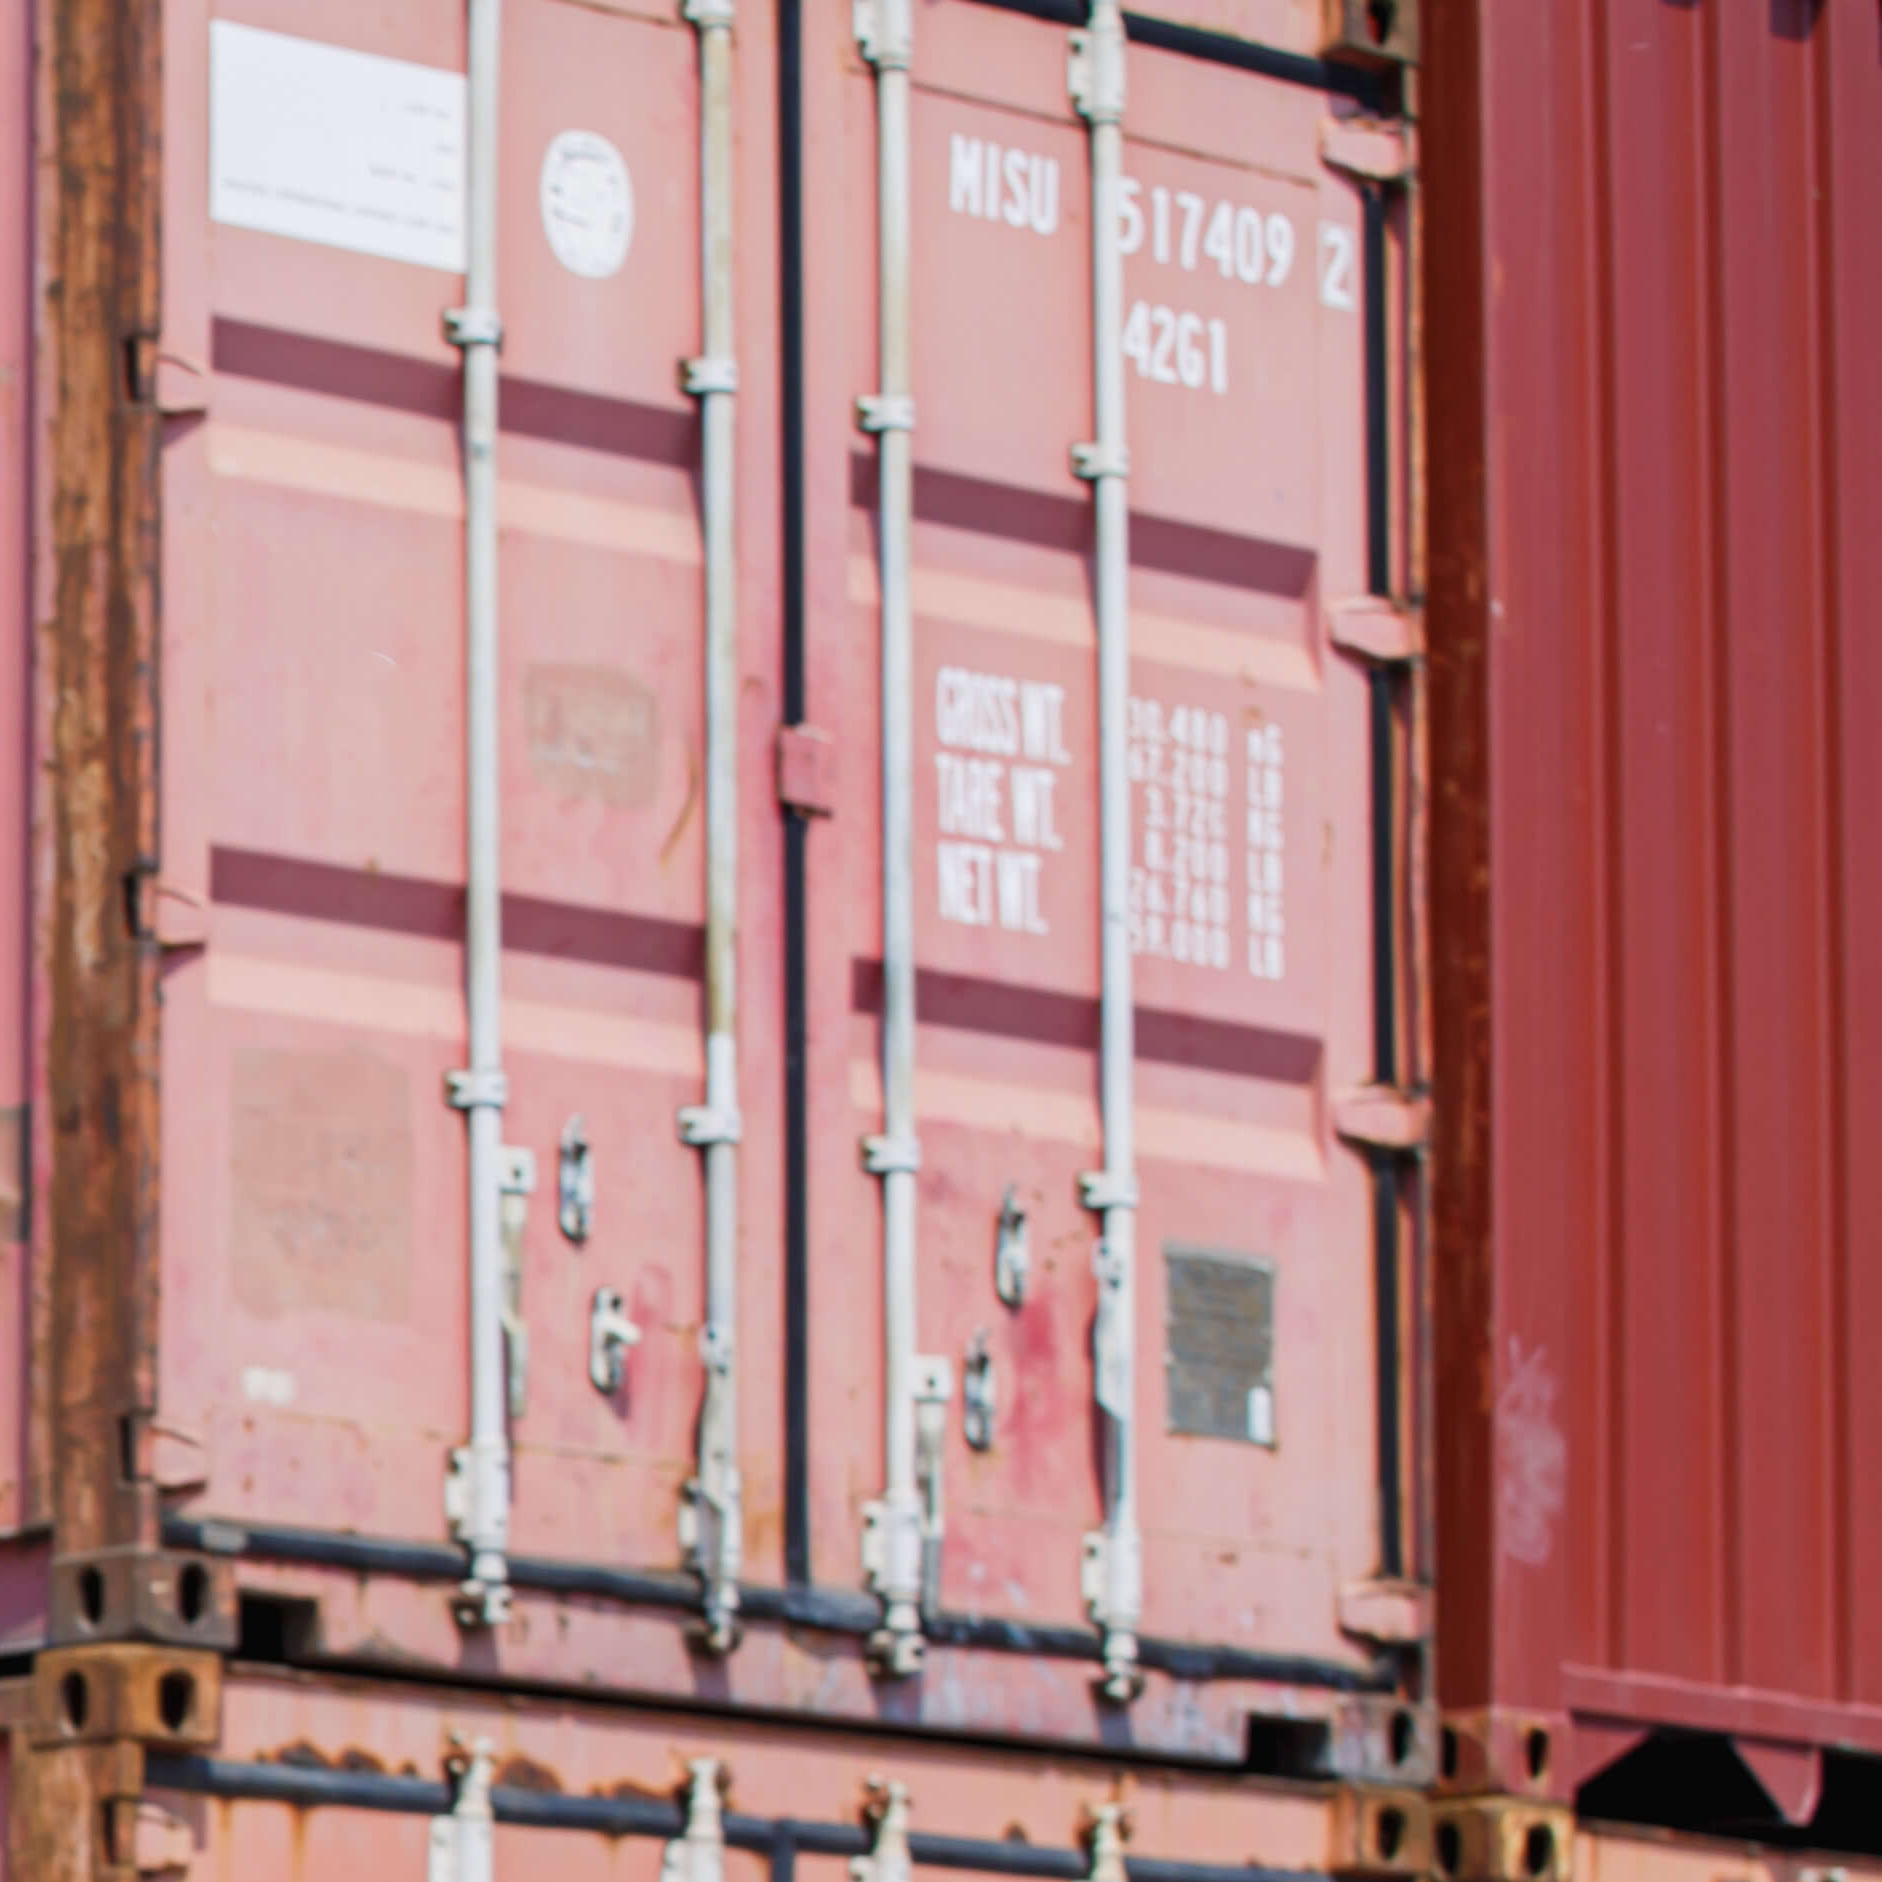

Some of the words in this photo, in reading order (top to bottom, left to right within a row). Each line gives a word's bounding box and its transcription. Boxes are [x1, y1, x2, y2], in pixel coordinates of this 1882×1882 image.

[949, 133, 1059, 236] MISU
[1117, 178, 1294, 287] 517409
[1321, 228, 1355, 311] 2
